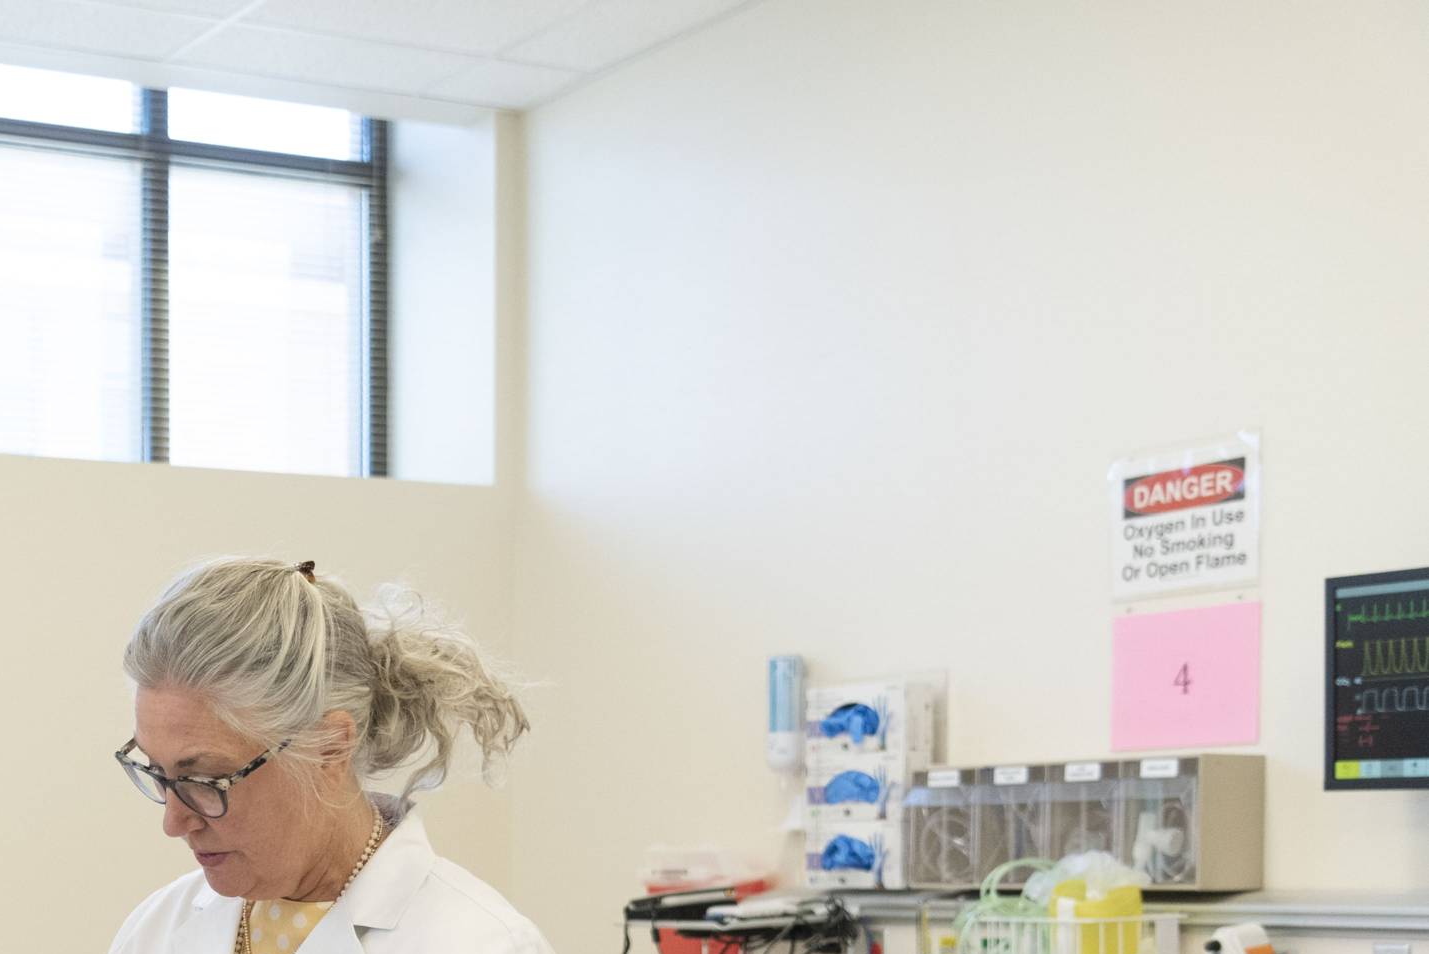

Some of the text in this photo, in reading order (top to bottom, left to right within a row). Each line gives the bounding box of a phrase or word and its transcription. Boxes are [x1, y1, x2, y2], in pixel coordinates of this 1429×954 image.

[1133, 469, 1234, 509] DANGER
[1123, 509, 1244, 541] Oxygen In Use
[1133, 533, 1234, 559] No Smoking
[1122, 552, 1247, 581] Or Open Flame
[1171, 662, 1194, 695] 4
